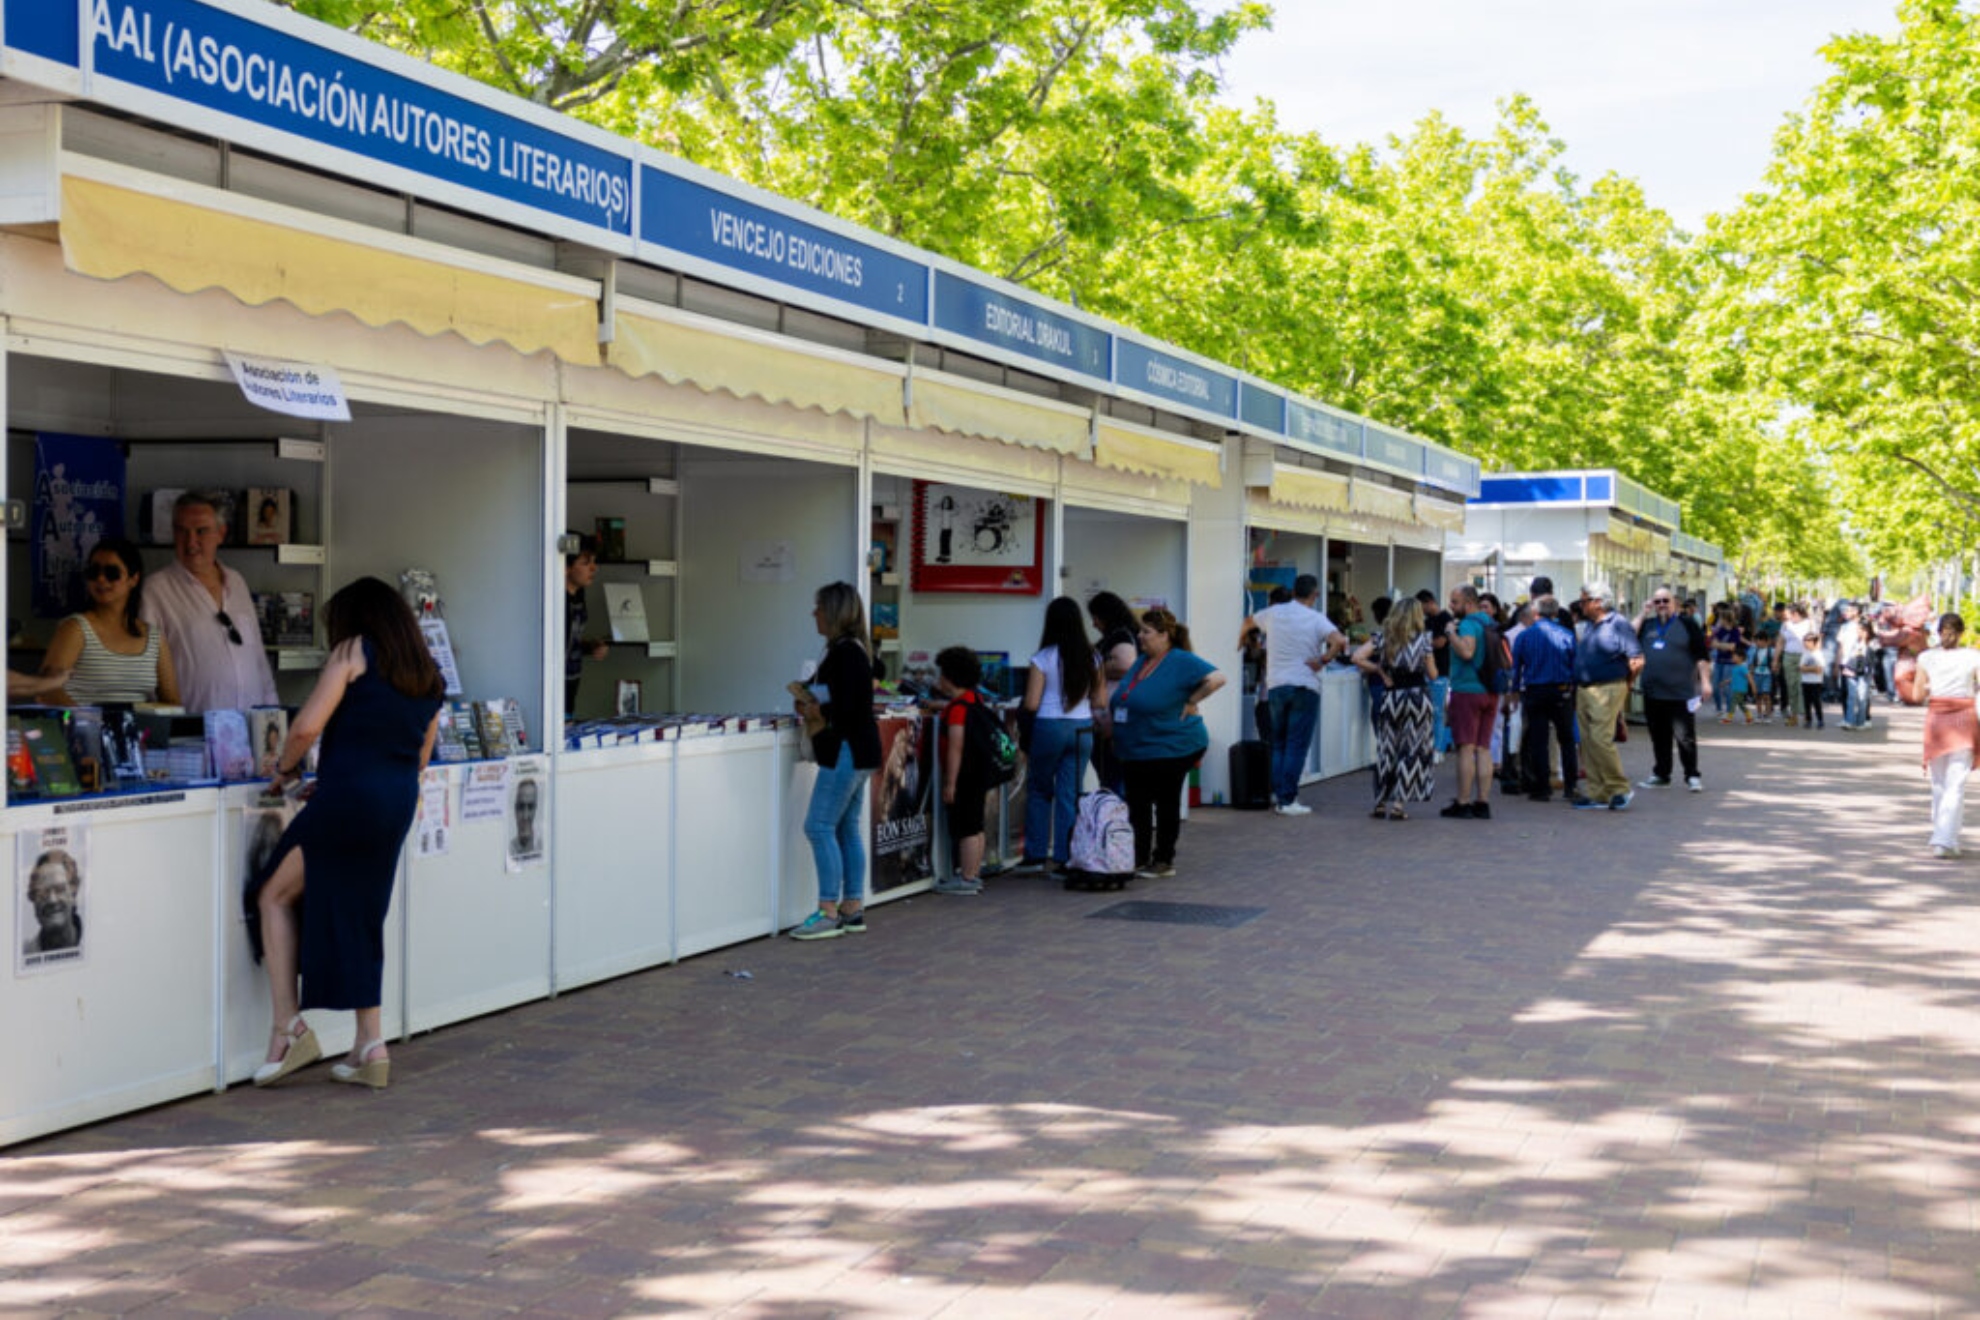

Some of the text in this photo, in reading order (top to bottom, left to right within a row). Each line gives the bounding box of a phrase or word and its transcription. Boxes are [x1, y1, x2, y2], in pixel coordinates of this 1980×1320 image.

[92, 0, 629, 224] AAL (ASOCIACIÓN AUTORES LITERARIOS)
[711, 208, 863, 288] VENCEJO EDICIONES
[985, 302, 1036, 344] EDITORIAL
[281, 387, 337, 407] Literarios
[305, 370, 319, 386] de
